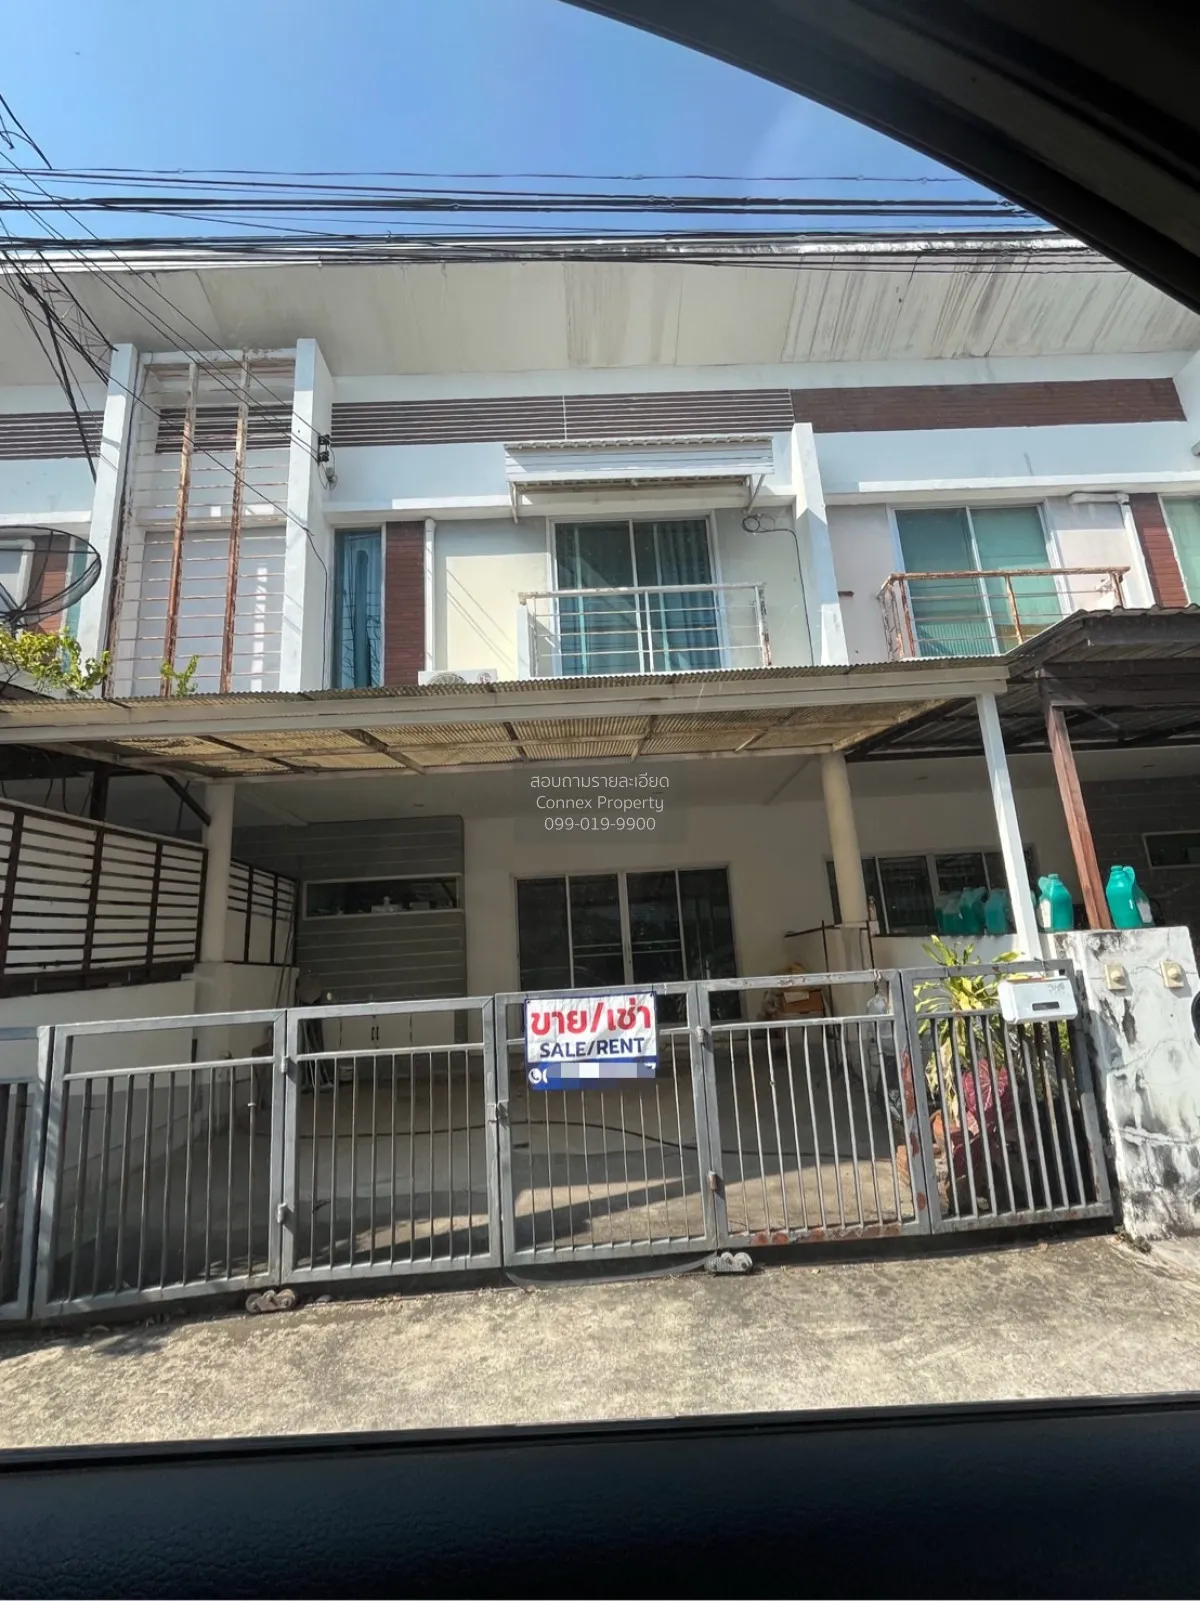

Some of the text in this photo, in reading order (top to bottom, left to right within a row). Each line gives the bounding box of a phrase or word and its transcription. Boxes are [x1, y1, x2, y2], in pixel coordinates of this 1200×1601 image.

[531, 997, 651, 1035] ขาย/เช่า
[540, 1037, 644, 1058] SALE/RENT
